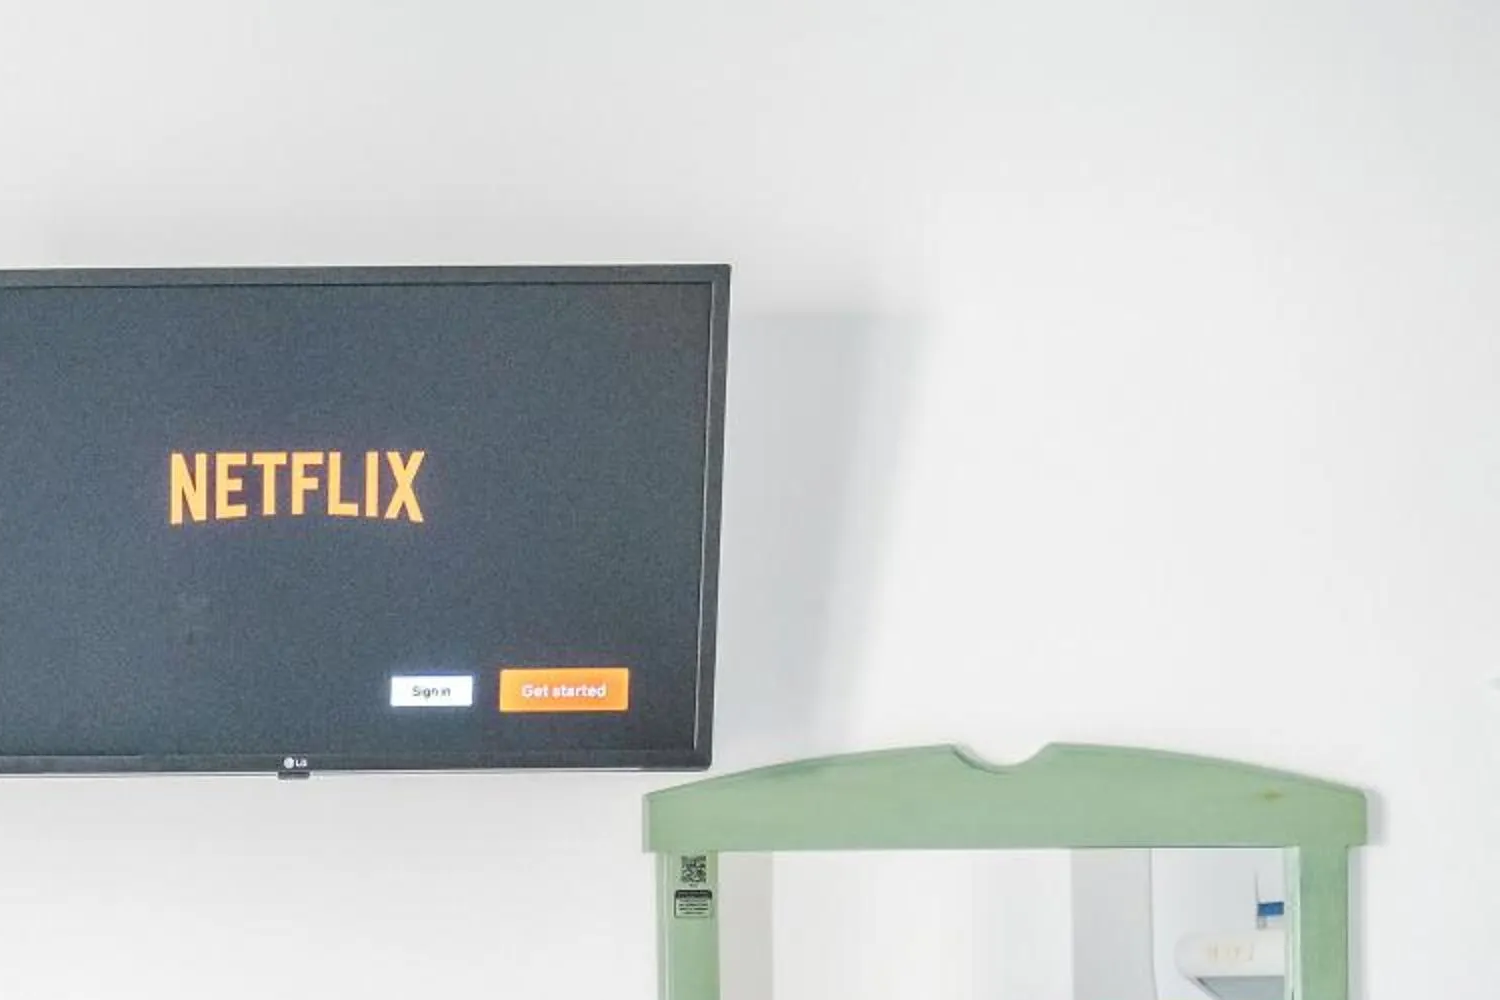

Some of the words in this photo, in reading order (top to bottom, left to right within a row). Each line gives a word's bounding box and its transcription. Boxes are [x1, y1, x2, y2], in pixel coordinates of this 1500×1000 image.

[170, 450, 425, 525] NETFLIX
[412, 685, 439, 701] Sign
[440, 686, 452, 698] in
[522, 684, 549, 698] Get
[551, 683, 607, 698] started
